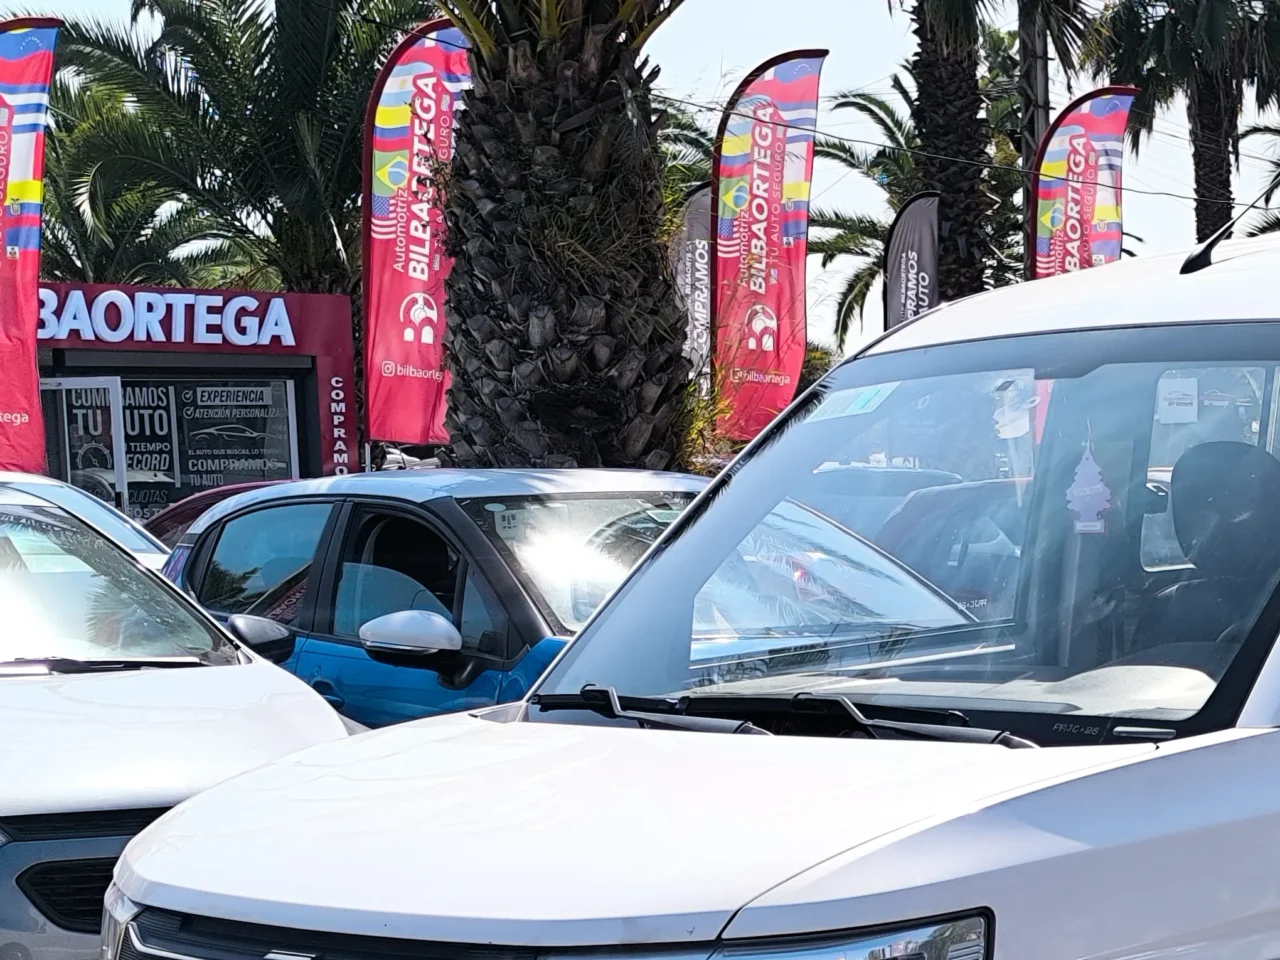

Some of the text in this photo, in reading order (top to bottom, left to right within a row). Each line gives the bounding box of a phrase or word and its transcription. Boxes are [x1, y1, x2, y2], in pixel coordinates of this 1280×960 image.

[438, 115, 450, 159] GURO
[772, 142, 784, 199] SEGURO
[750, 106, 774, 295] BILBAORTEGA
[393, 188, 408, 273] Automotriz
[770, 203, 780, 242] AUTO
[738, 210, 749, 287] Automotriz
[200, 389, 265, 403] EXPERIENCIA
[73, 409, 169, 436] TU UTO
[194, 407, 230, 419] ATENCIÓN
[130, 442, 171, 452] TIEMPO
[126, 454, 170, 471] ECORD
[188, 458, 279, 471] COMPRAMOS
[189, 474, 224, 486] TU AUTO
